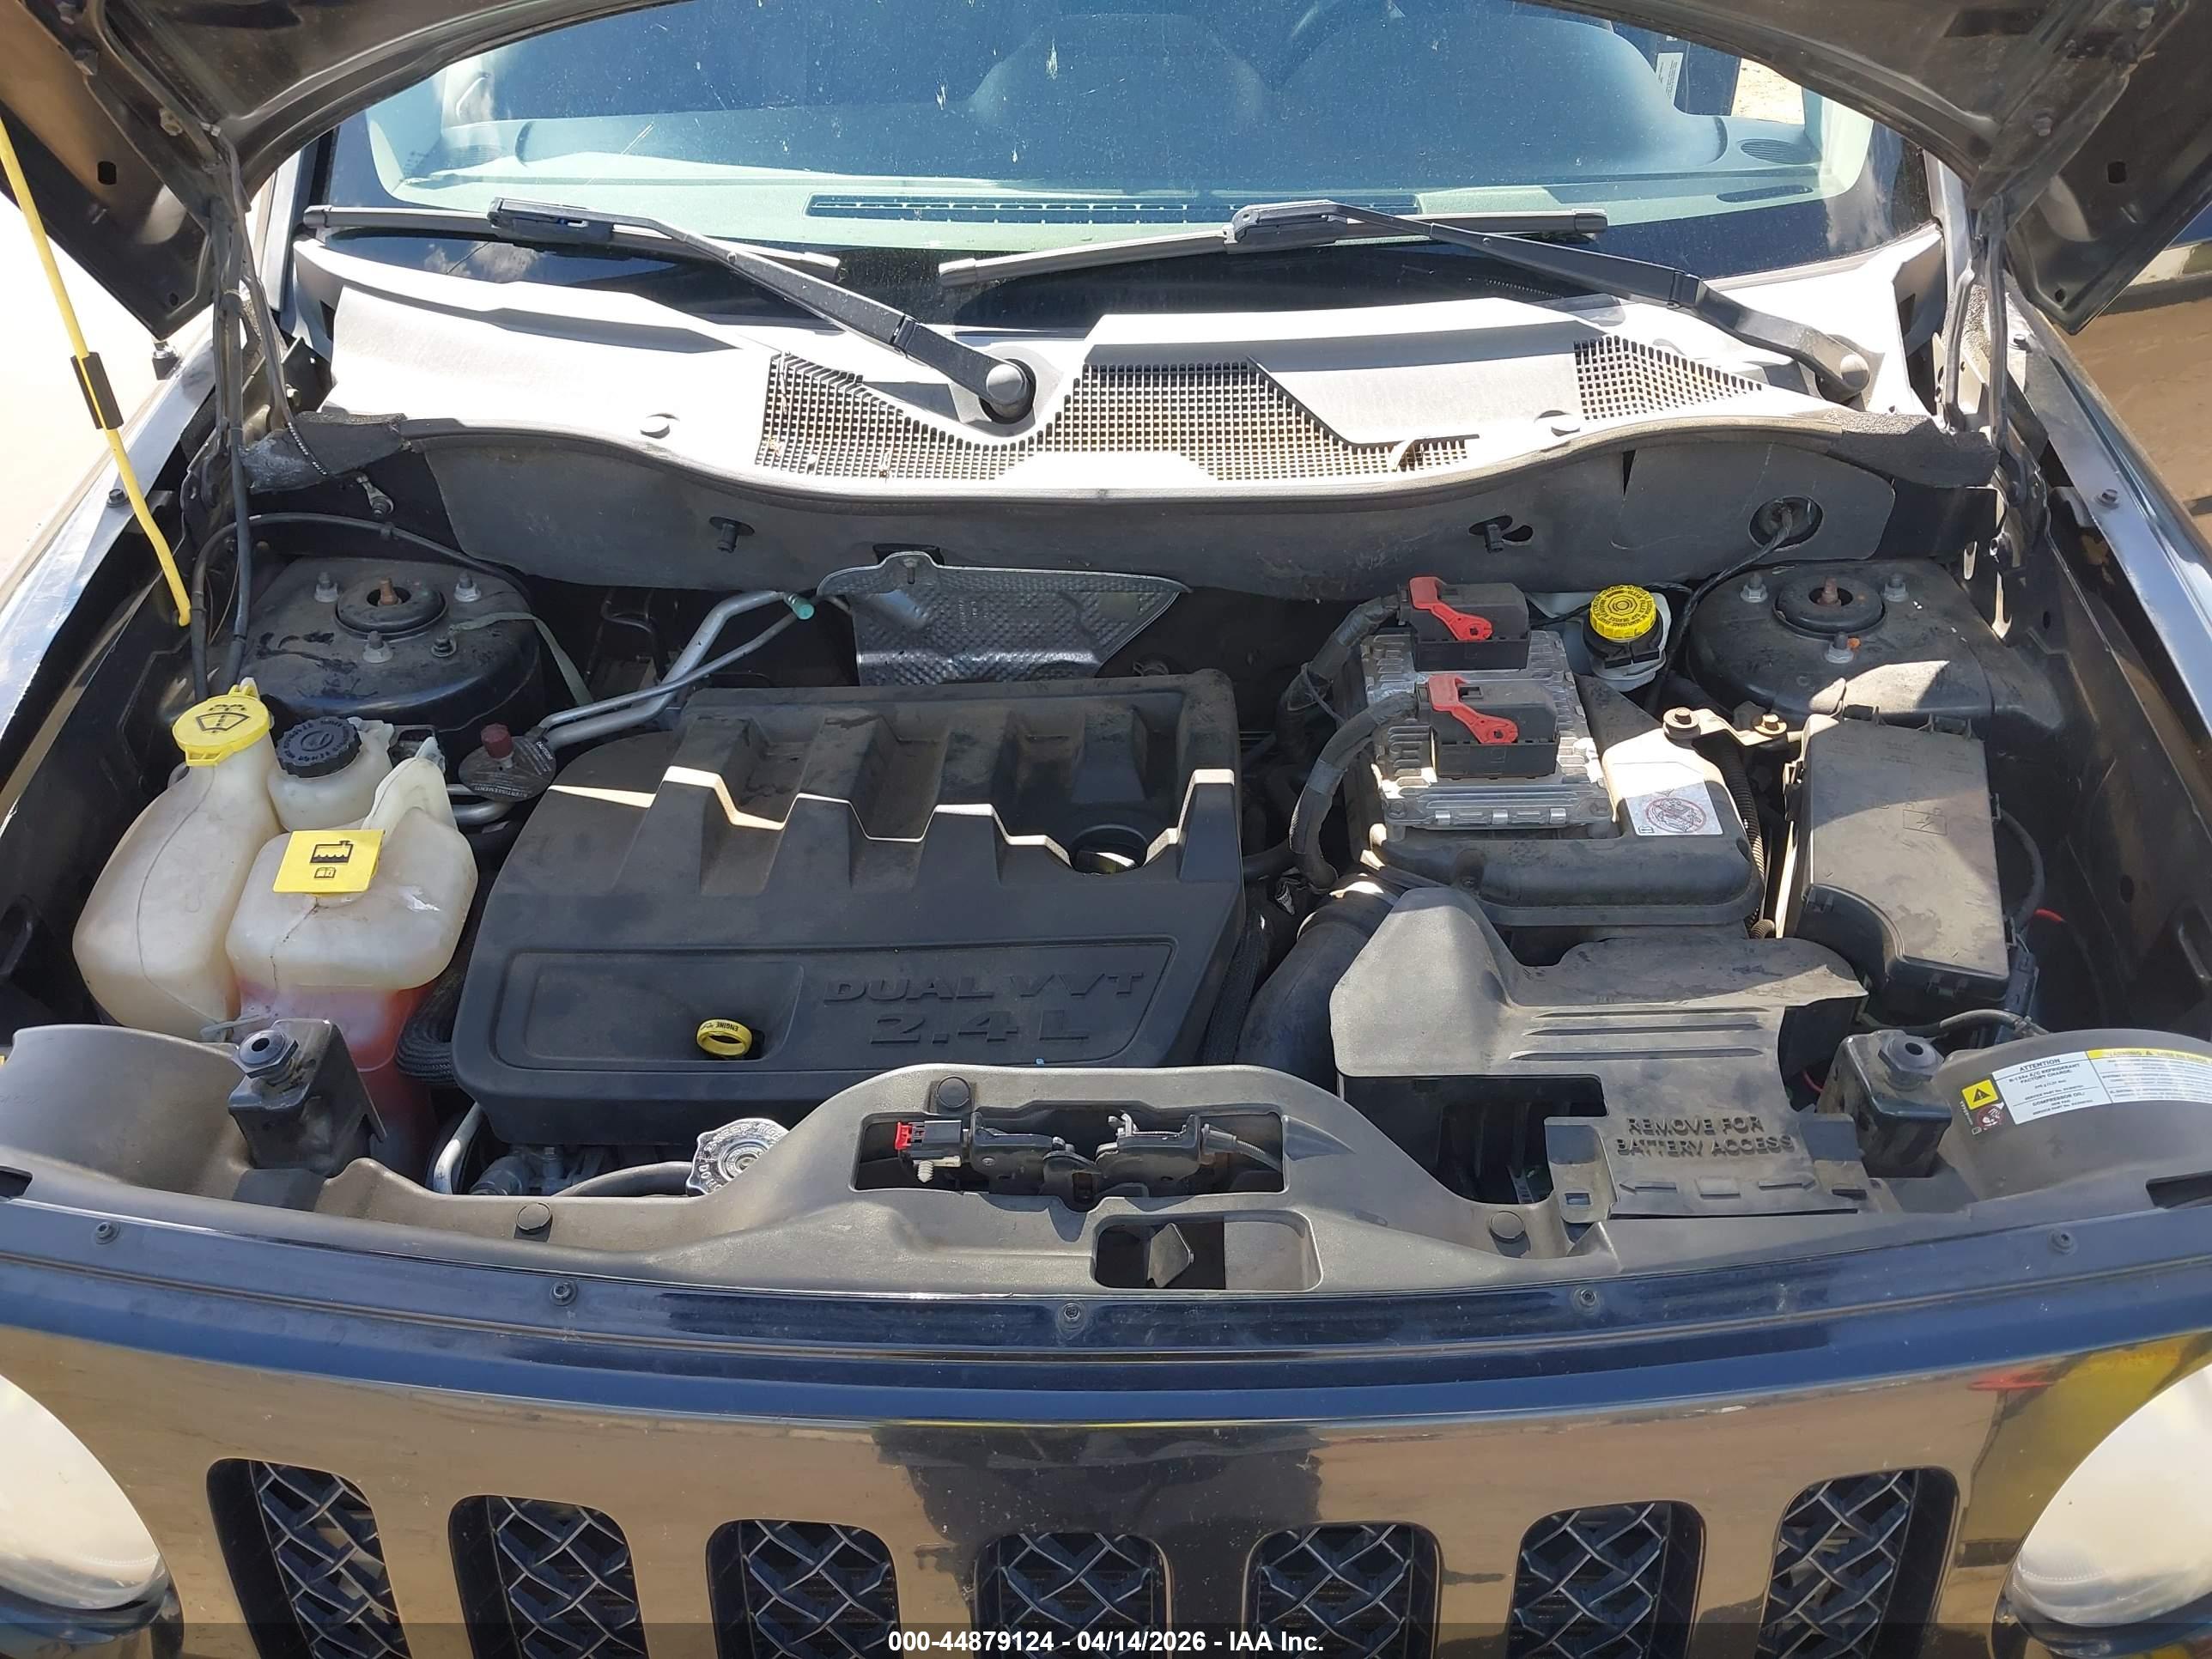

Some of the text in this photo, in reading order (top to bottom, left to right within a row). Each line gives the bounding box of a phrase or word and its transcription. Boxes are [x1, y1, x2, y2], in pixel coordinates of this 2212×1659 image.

[824, 972, 1145, 1004] DUAL VVT
[716, 1021, 739, 1032] ENGINE
[2019, 1058, 2061, 1073] ATTENTION
[2020, 1074, 2046, 1084] FACTORY
[2032, 1092, 2072, 1107] COMPRESSOR
[757, 1123, 781, 1142] TIGH
[1628, 1115, 1765, 1136] REMOVE FOR
[1616, 1135, 1796, 1158] BATTERY ACCESS
